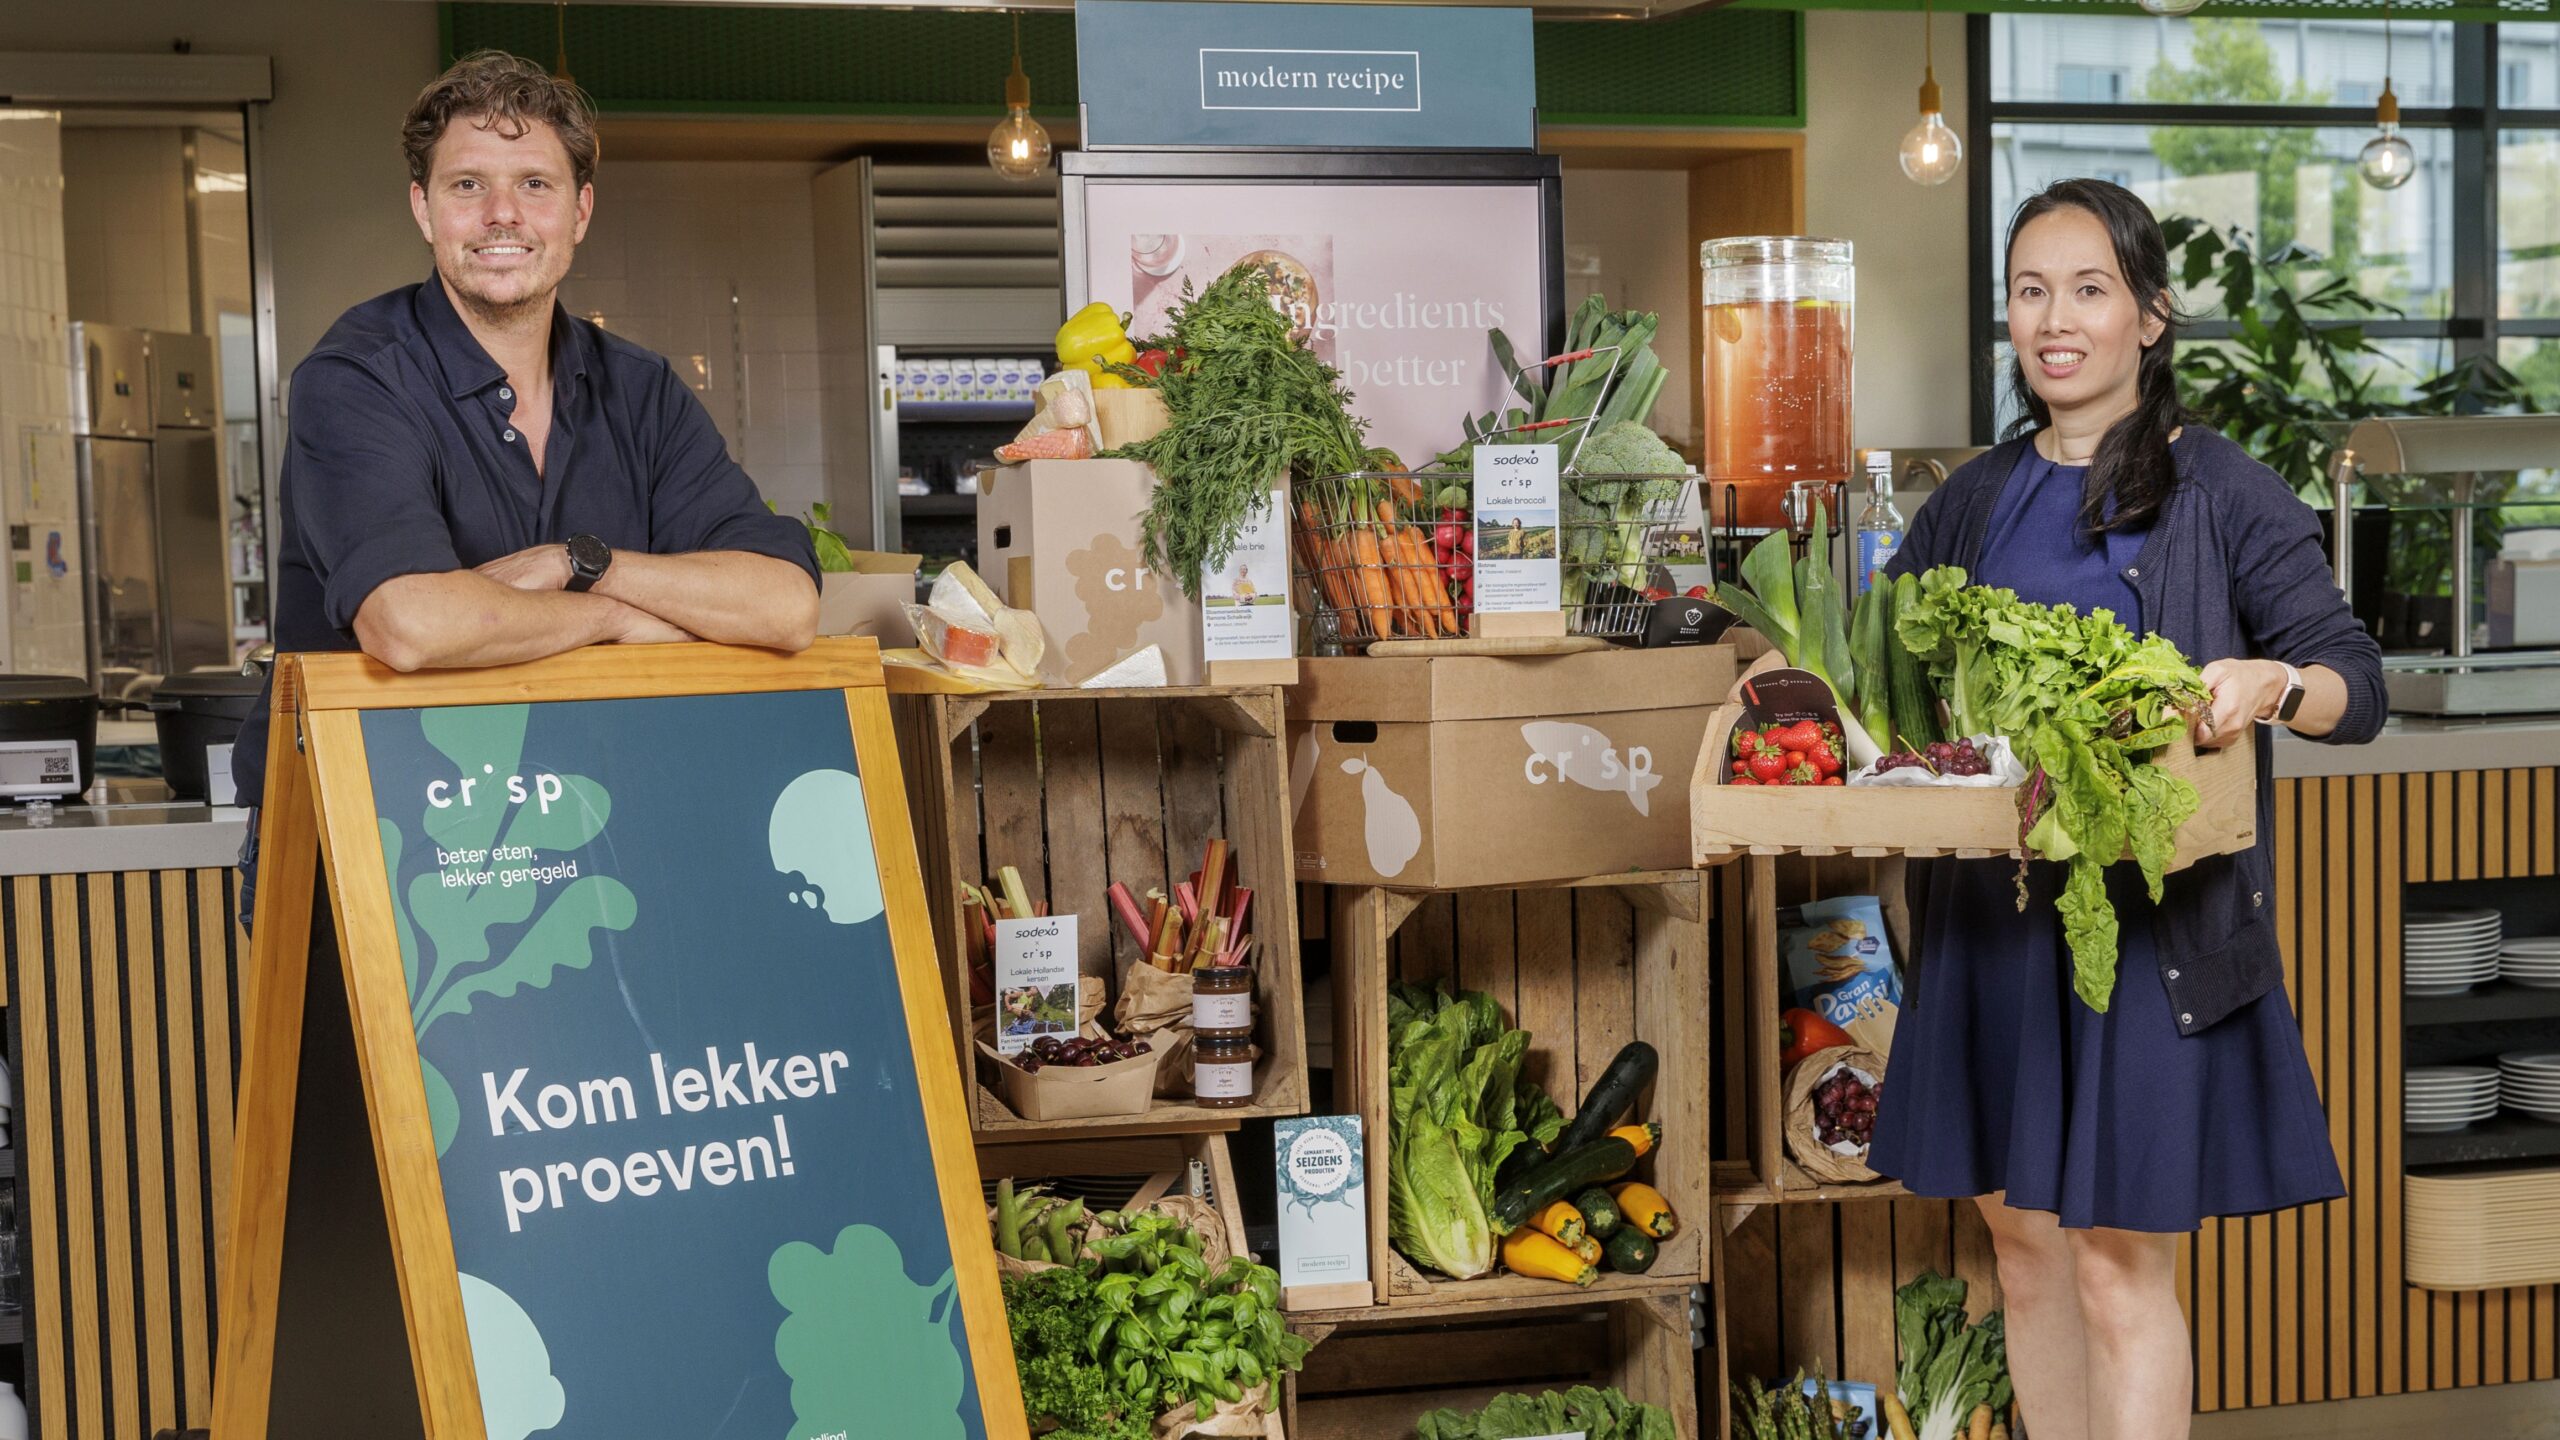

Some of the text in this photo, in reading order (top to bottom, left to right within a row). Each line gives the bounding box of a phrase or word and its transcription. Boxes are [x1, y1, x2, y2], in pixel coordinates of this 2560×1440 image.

[1217, 66, 1404, 95] modern recipe
[1269, 292, 1505, 341] Ingredients
[1343, 350, 1466, 387] better
[1493, 450, 1539, 465] sodexo
[1486, 496, 1546, 505] Lokale broccoli
[1249, 543, 1265, 551] brie
[437, 844, 538, 865] beter eten,
[441, 860, 578, 888] lekker geregeld
[1015, 922, 1059, 939] sodexo
[1010, 966, 1064, 976] Lokale Hollandse
[1837, 980, 1870, 1001] Gran
[482, 1042, 849, 1136] Kom lekker
[1296, 1155, 1343, 1168] SEIZOENS
[499, 1114, 795, 1233] proeven!
